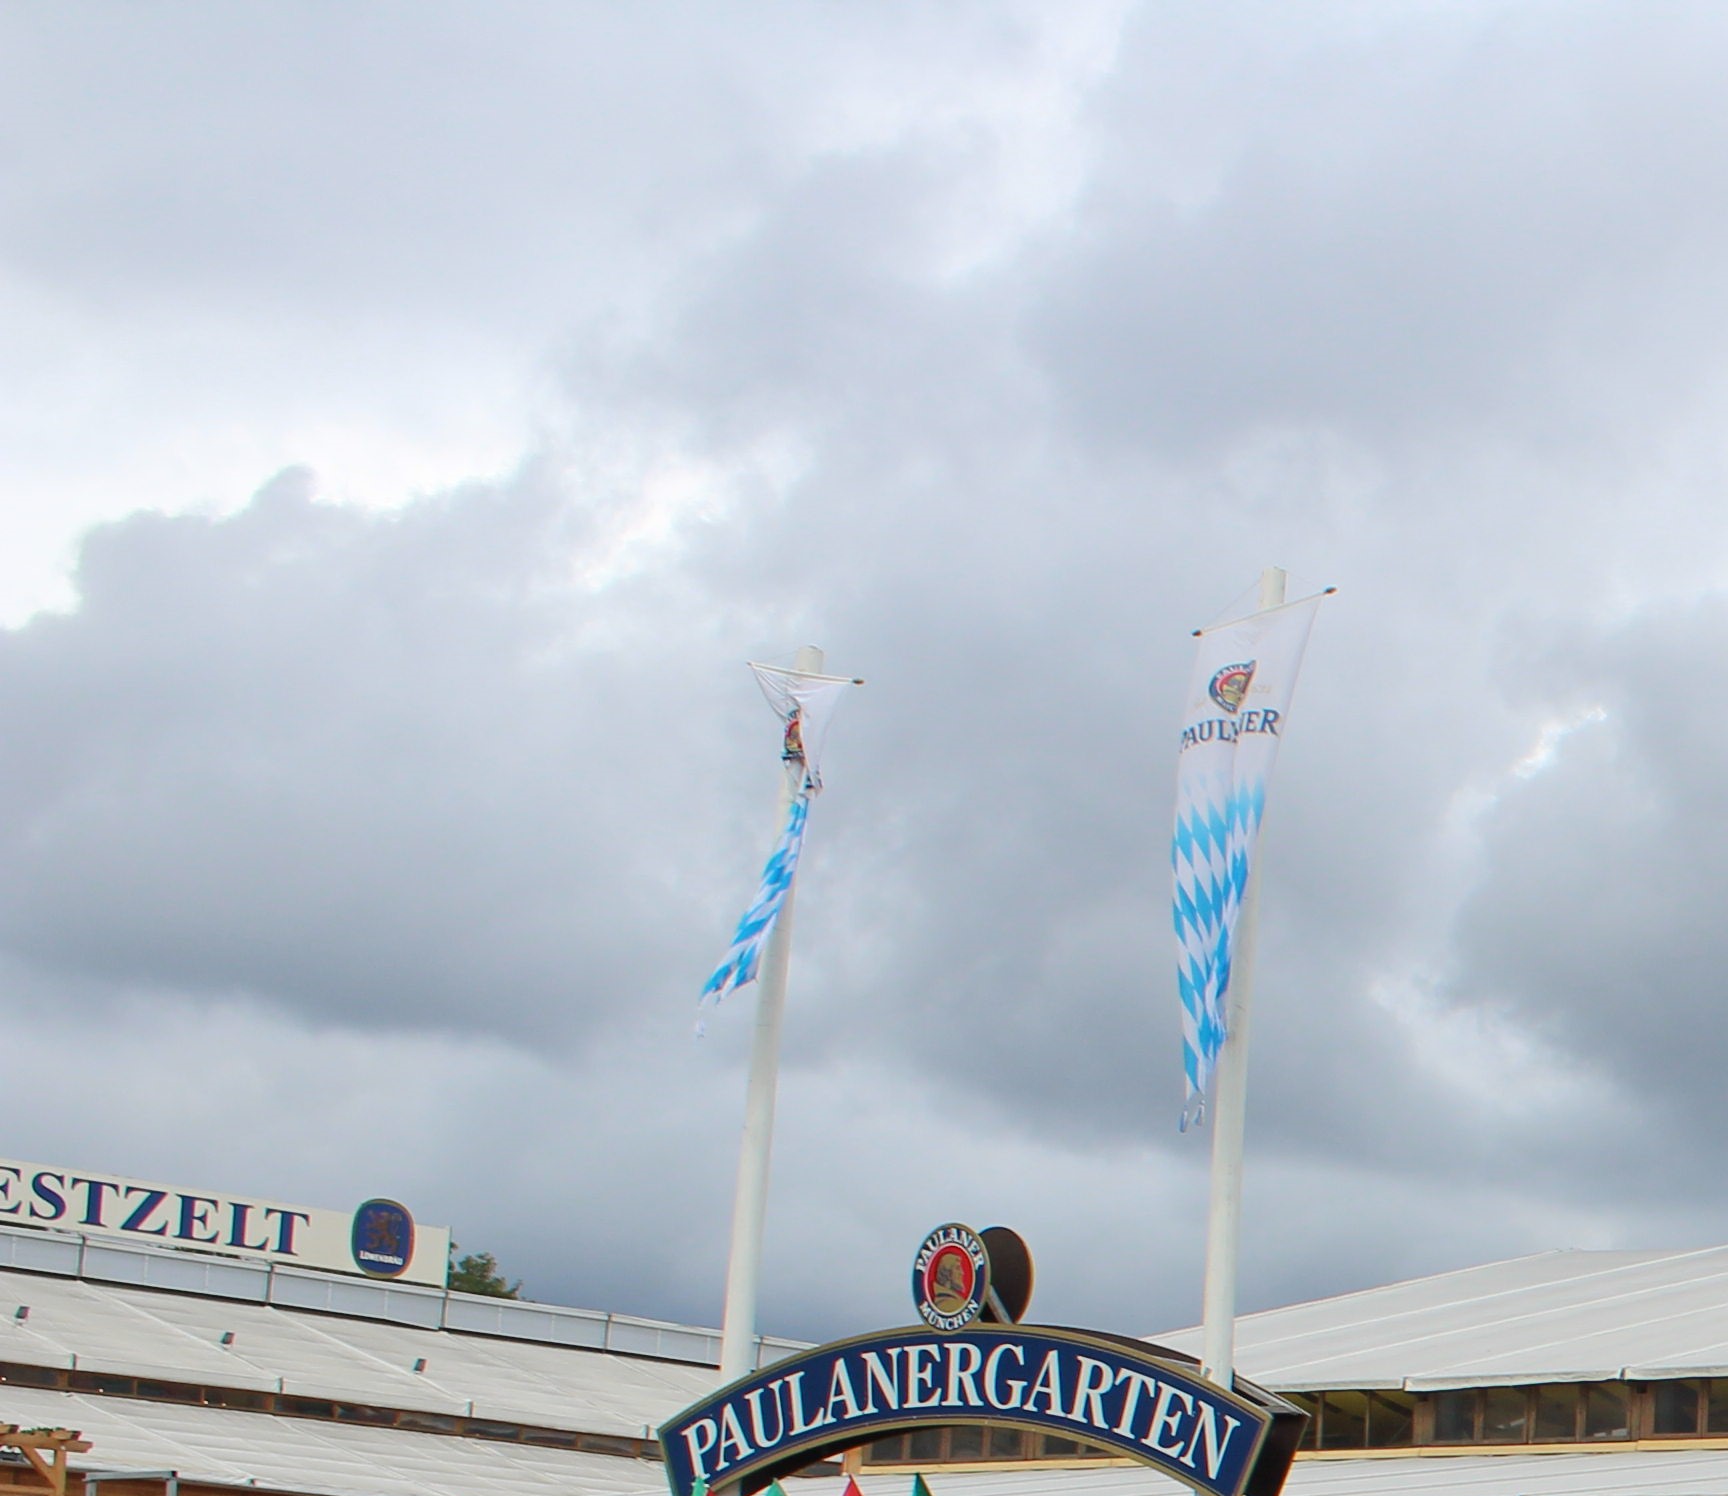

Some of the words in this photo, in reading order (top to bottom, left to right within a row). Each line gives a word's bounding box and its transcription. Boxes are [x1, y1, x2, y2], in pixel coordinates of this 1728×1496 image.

[916, 1227, 984, 1273] PAULANER
[919, 1299, 979, 1331] MÜNCHEN
[681, 1342, 1241, 1484] PAULANERGARTEN
